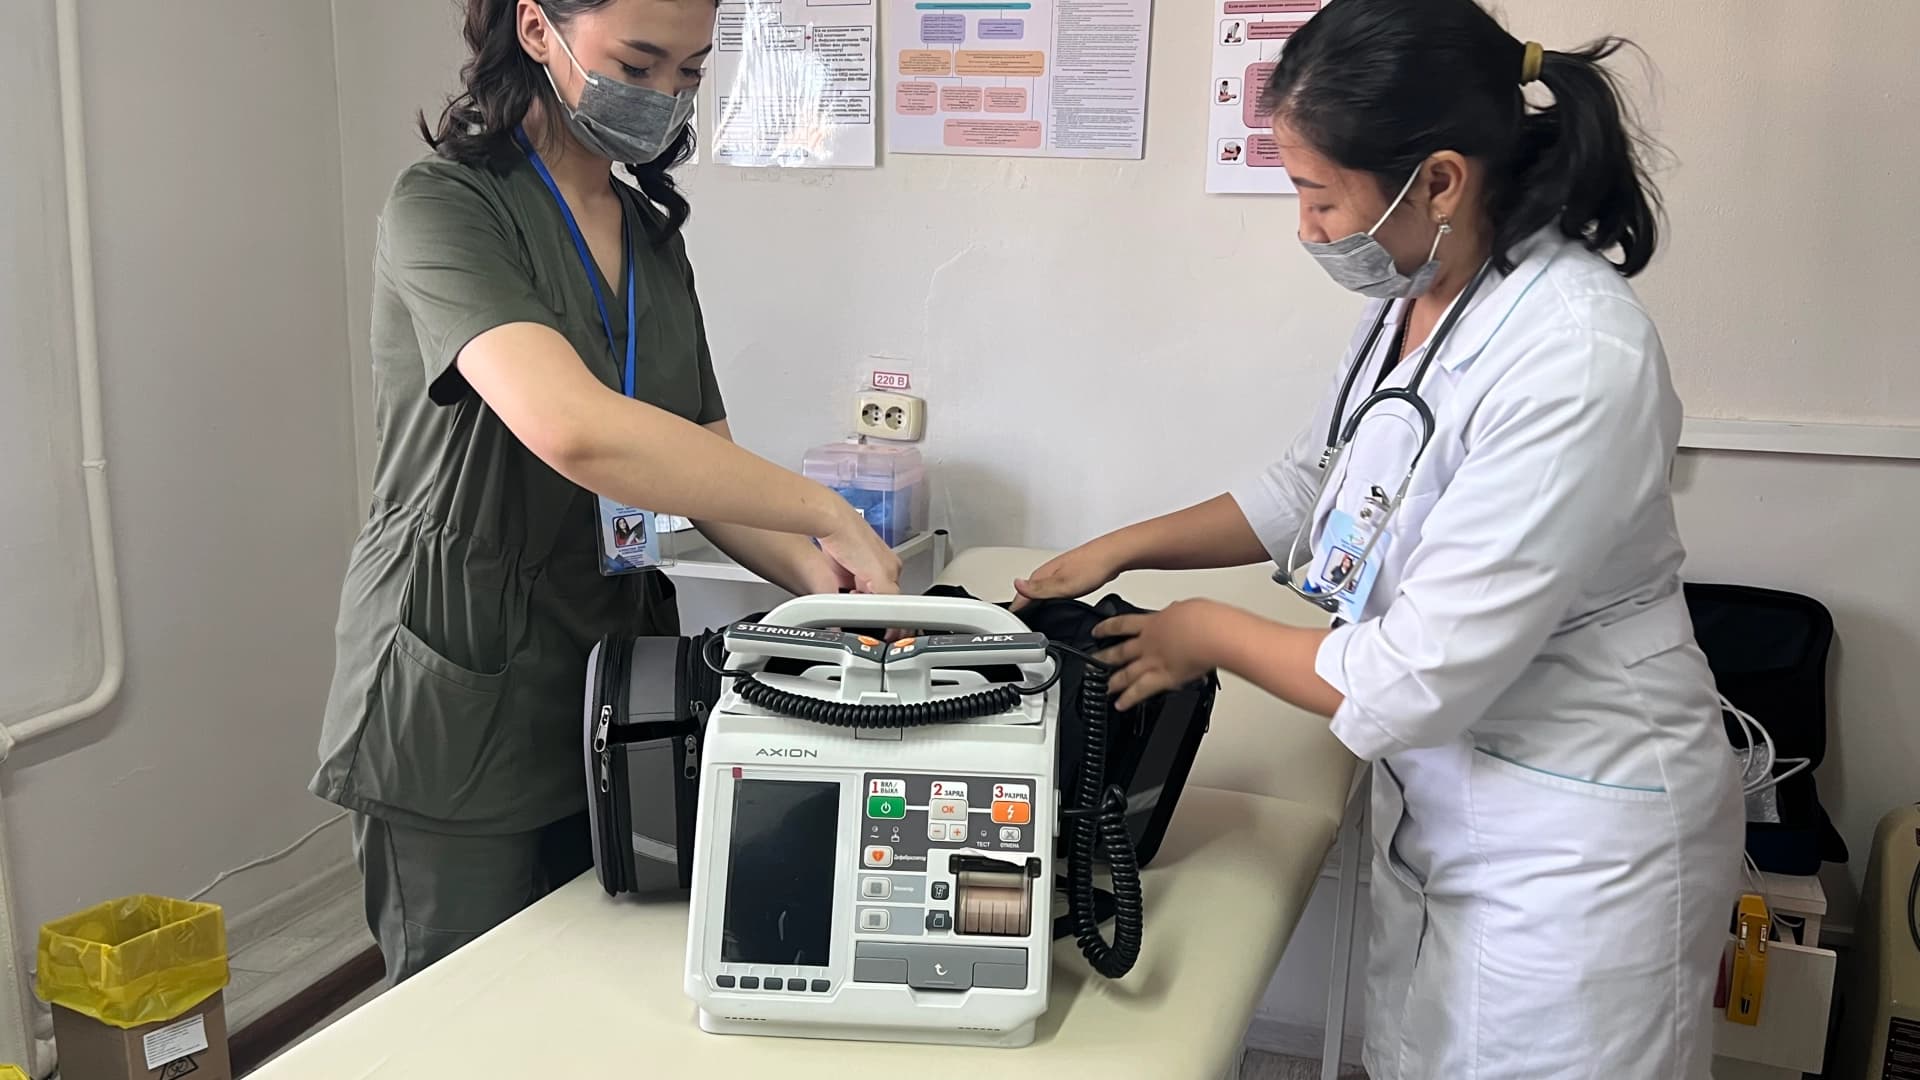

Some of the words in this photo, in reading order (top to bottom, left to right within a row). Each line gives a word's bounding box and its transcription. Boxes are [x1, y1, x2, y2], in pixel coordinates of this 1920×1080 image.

[877, 375, 895, 385] 220
[736, 623, 816, 638] STERNUM
[970, 634, 1015, 643] APEX
[755, 748, 818, 758] AXION
[872, 781, 879, 793] 1
[933, 783, 943, 796] 2
[995, 785, 1004, 798] 3
